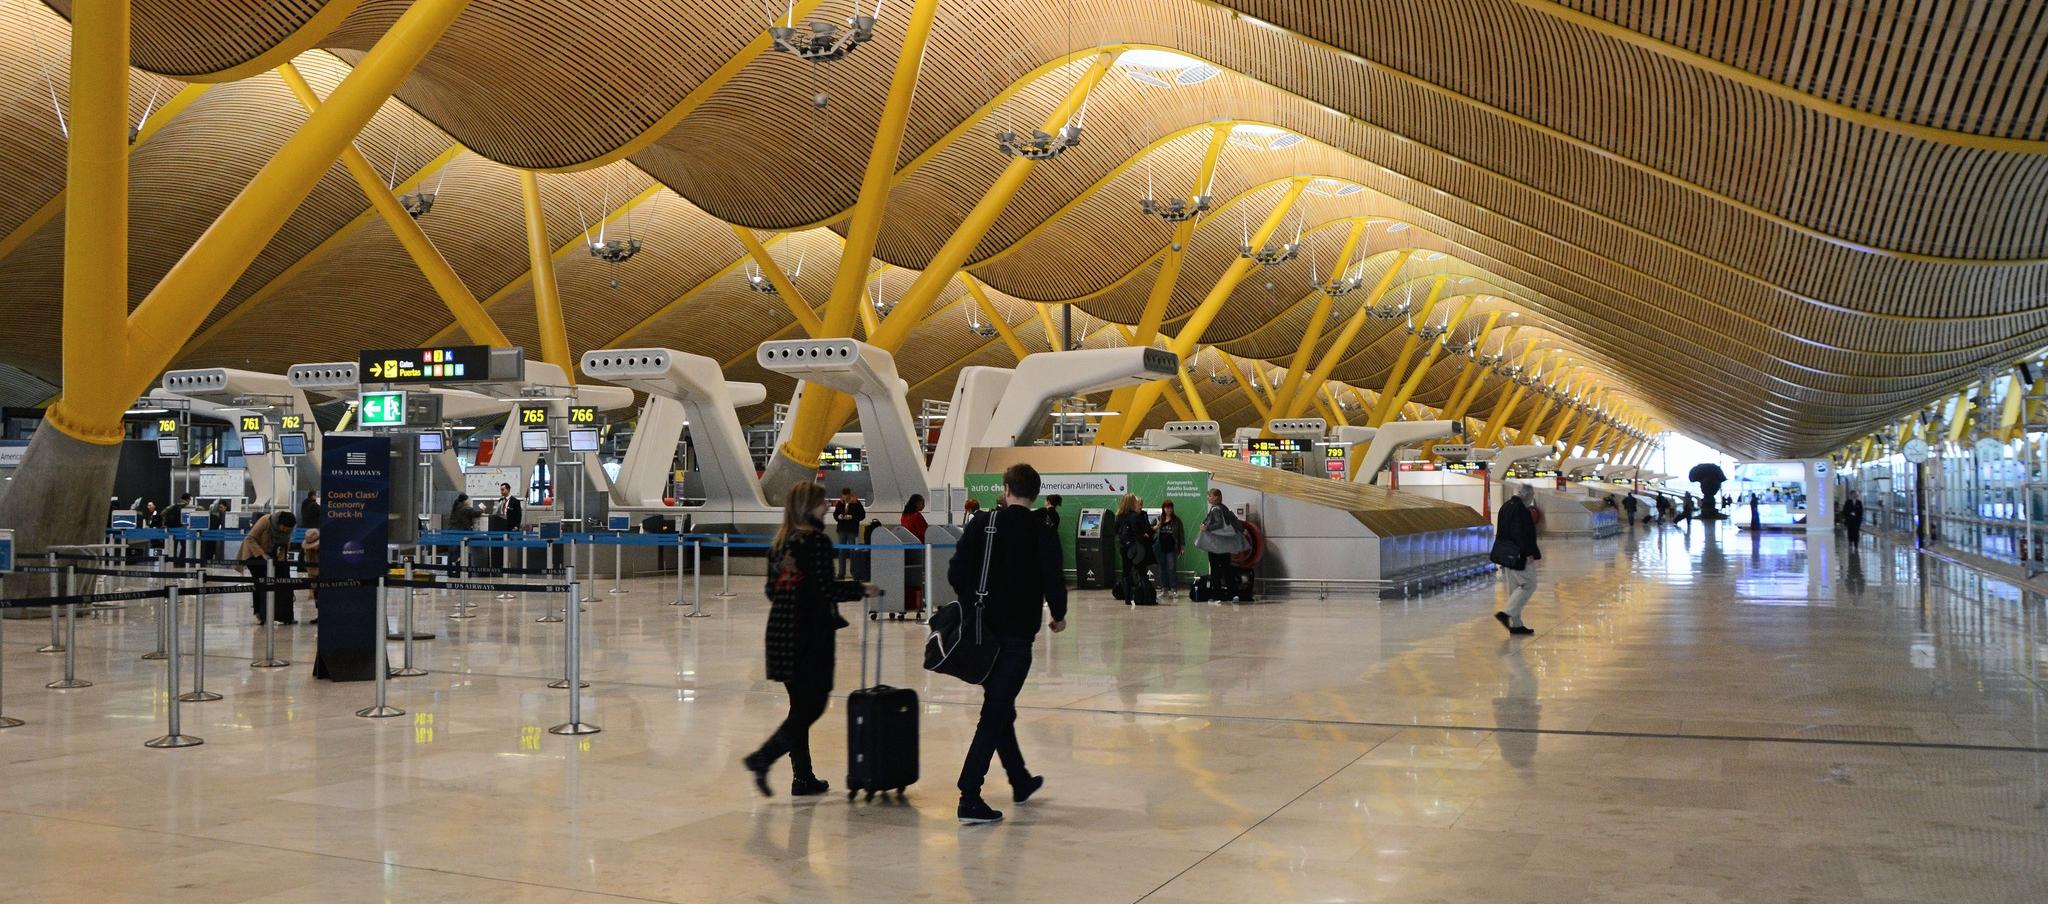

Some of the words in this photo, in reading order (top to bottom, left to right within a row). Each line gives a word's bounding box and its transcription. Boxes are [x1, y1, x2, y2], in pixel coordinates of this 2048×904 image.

[445, 350, 453, 361] K
[399, 369, 421, 377] Puertas
[522, 409, 545, 423] 765
[571, 408, 594, 422] 766
[159, 420, 176, 431] 760
[243, 418, 260, 430] 761
[281, 416, 300, 428] 762
[1222, 449, 1237, 458] 797
[1327, 448, 1343, 457] 799
[971, 484, 989, 492] auto
[1041, 482, 1075, 490] American
[1076, 482, 1104, 490] Airlines
[328, 491, 353, 499] Coach
[355, 491, 379, 499] Class/
[328, 501, 366, 510] Economy
[328, 510, 363, 519] Check-In
